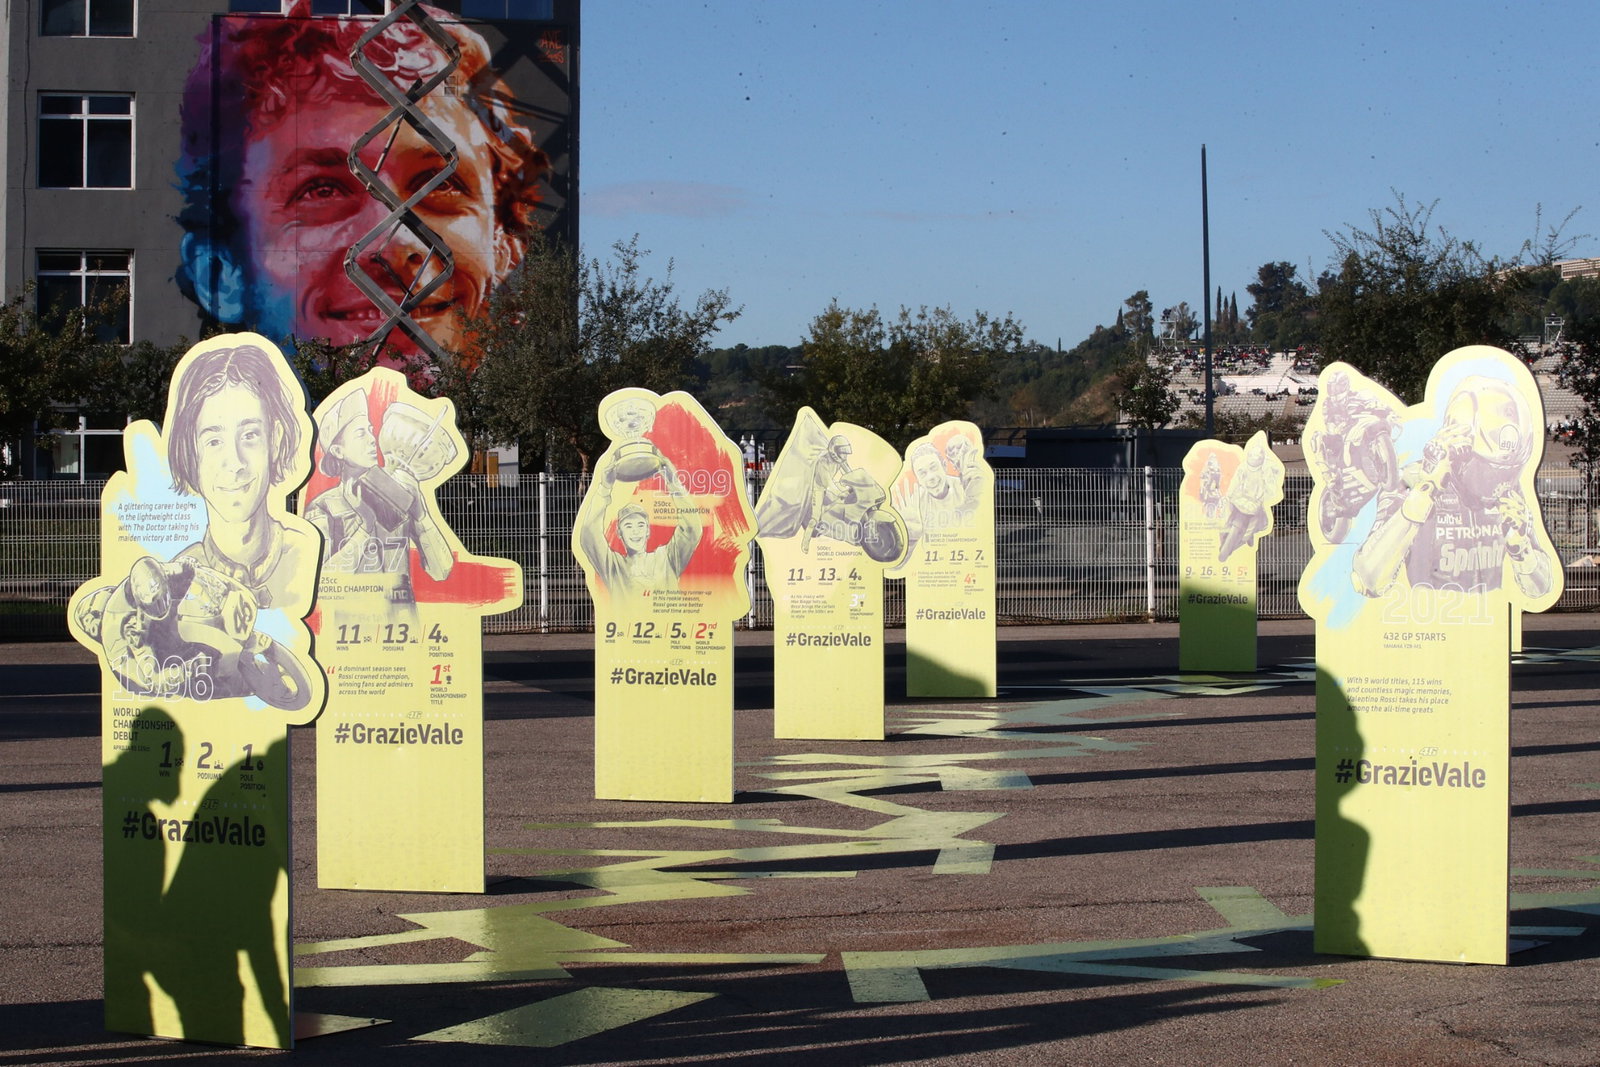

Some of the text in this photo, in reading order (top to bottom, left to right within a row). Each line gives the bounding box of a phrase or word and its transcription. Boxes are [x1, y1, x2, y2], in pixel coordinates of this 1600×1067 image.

[653, 469, 732, 497] 1999
[124, 503, 153, 512] glittering
[176, 503, 197, 511] begins
[125, 513, 135, 521] the
[137, 514, 173, 522] lightweight
[167, 524, 188, 533] taking
[815, 520, 878, 543] 2001
[142, 534, 164, 543] victory
[925, 551, 938, 561] 11
[950, 550, 964, 561] 15
[975, 550, 983, 560] 7
[788, 568, 805, 581] 11
[818, 568, 836, 581] 13
[848, 568, 858, 581] 4
[1186, 567, 1192, 576] 9
[1201, 566, 1213, 575] 16
[1222, 566, 1228, 576] 9
[319, 577, 338, 585] 25cc
[344, 585, 384, 593] CHAMPION
[1189, 594, 1248, 604] #GrazieVale
[1382, 582, 1494, 625] 2021
[916, 608, 986, 620] #GrazieVale
[336, 624, 361, 644] 11
[382, 623, 409, 644] 13
[428, 623, 443, 644] 4
[605, 622, 616, 639] 9
[632, 622, 655, 639] 12
[670, 622, 682, 639] 5
[786, 632, 871, 646] #GrazieVale
[1383, 633, 1446, 641] 432 GP STARTS
[112, 655, 214, 703] 1996
[610, 668, 717, 686] #GrazieVale
[1347, 676, 1362, 684] With
[1390, 678, 1410, 686] titles,
[1416, 688, 1452, 696] memories,
[1399, 696, 1417, 704] takes
[1430, 697, 1449, 705] place
[113, 708, 142, 717] WORLD
[1347, 705, 1369, 713] among
[1383, 705, 1410, 713] all-time
[113, 720, 176, 730] CHAMPIONSHIP
[113, 732, 138, 741] DEBUT
[334, 722, 463, 745] #GrazieVale
[159, 741, 172, 768] 1
[197, 742, 213, 769] 2
[240, 744, 254, 770] 1
[1335, 758, 1486, 788] #GrazieVale
[122, 811, 266, 847] #GrazieVale
